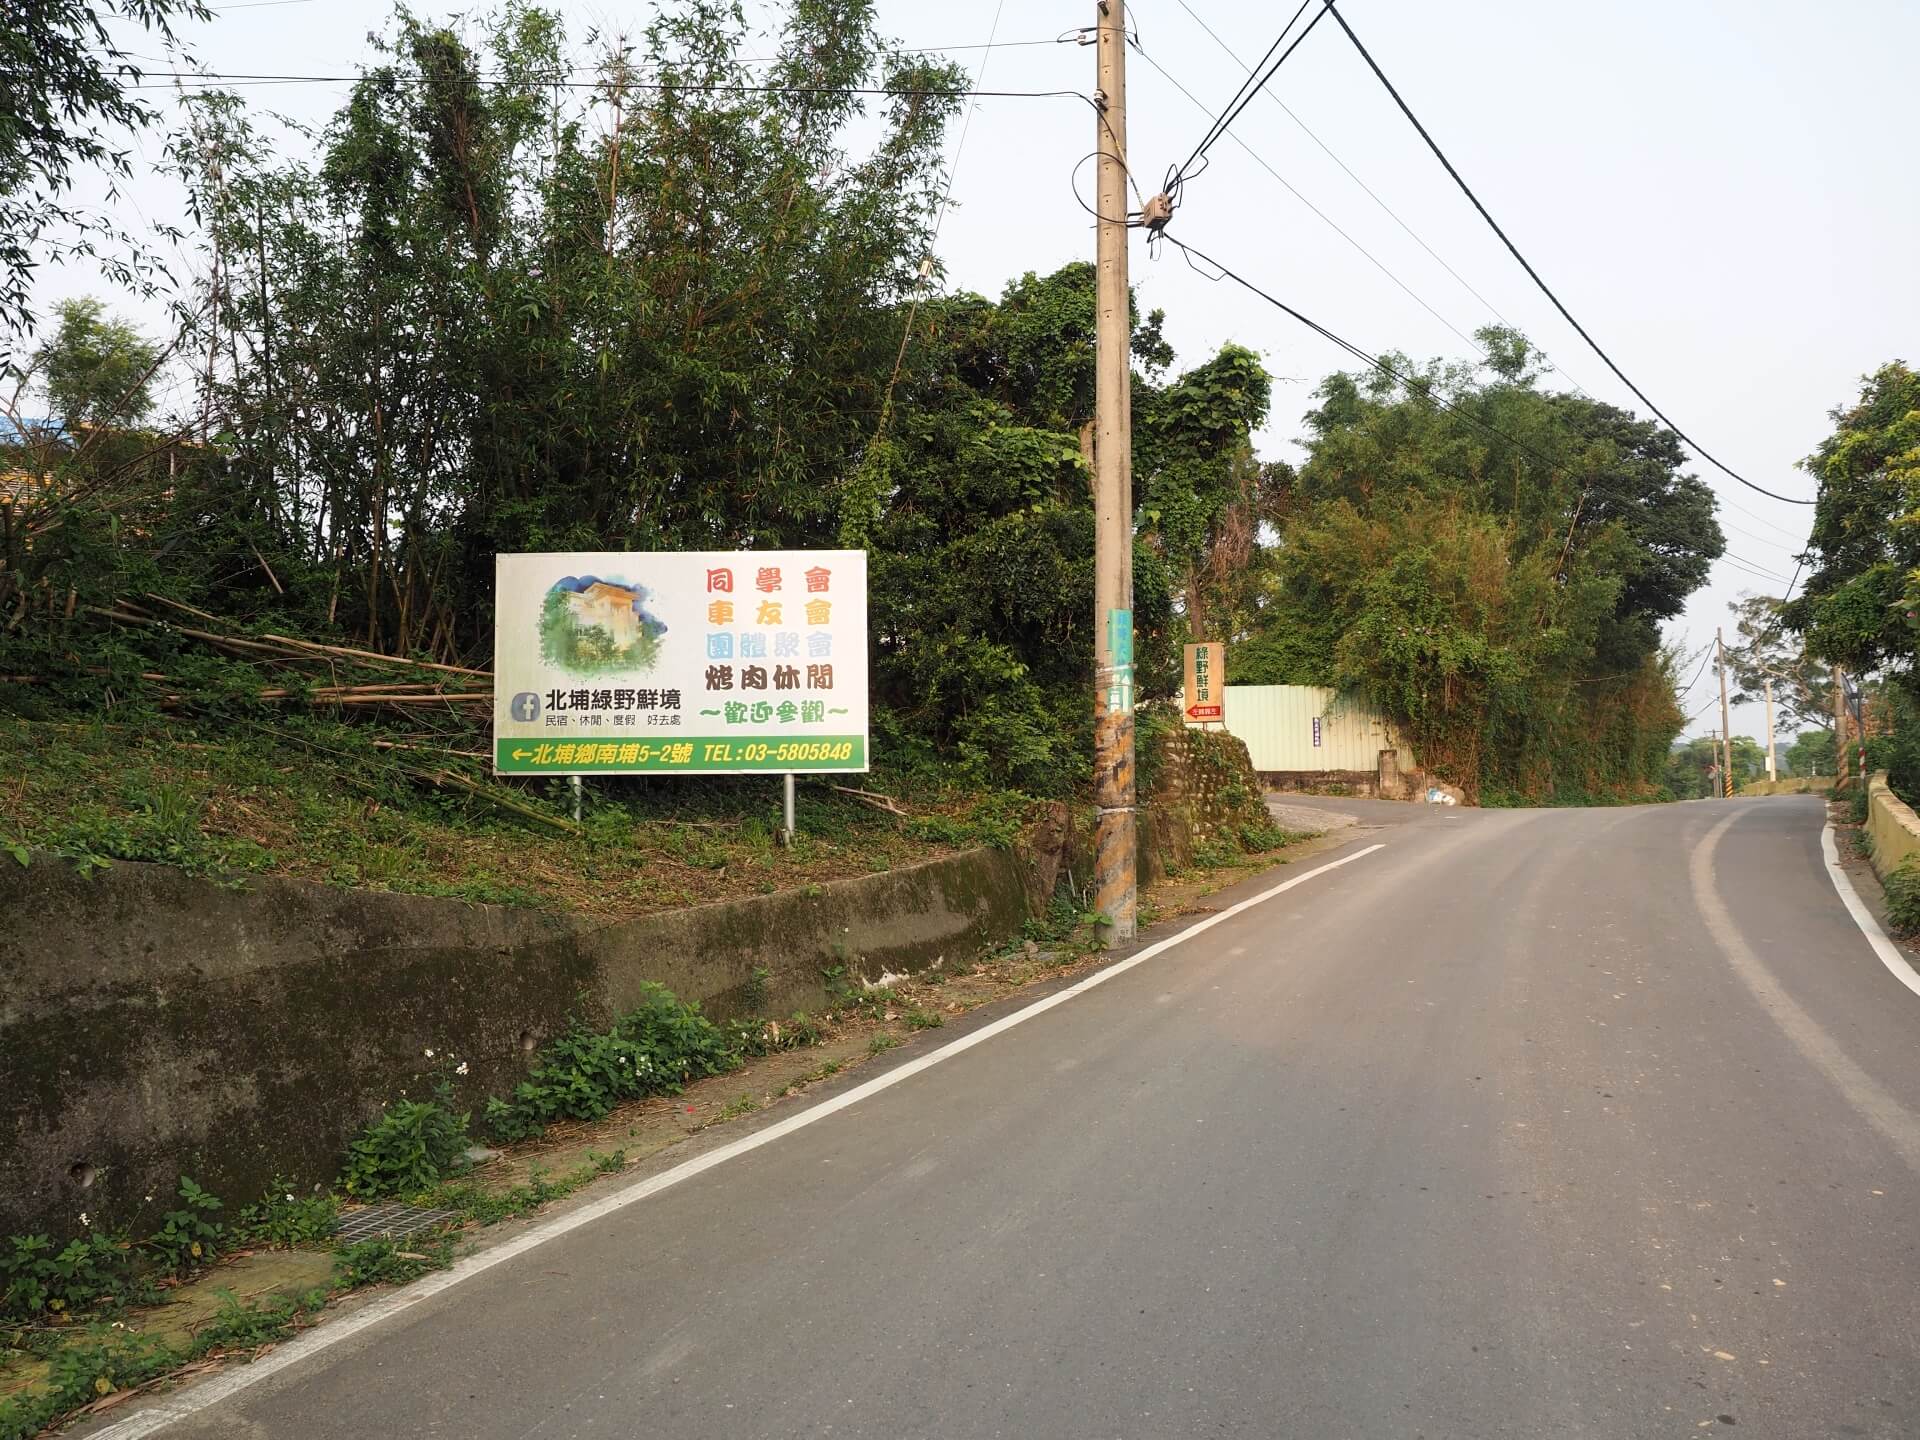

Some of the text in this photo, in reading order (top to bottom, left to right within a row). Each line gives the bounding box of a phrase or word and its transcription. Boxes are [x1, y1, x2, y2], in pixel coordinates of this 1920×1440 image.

[706, 566, 832, 593] 同學會
[708, 598, 832, 625] 車友會
[706, 631, 833, 660] 團體聚會
[1196, 646, 1209, 702] 綠野鮮境
[545, 689, 681, 711] 北埔綠野鮮境
[530, 743, 852, 765] 北埔鄉南埔5-2號 TEL:03-5805848
